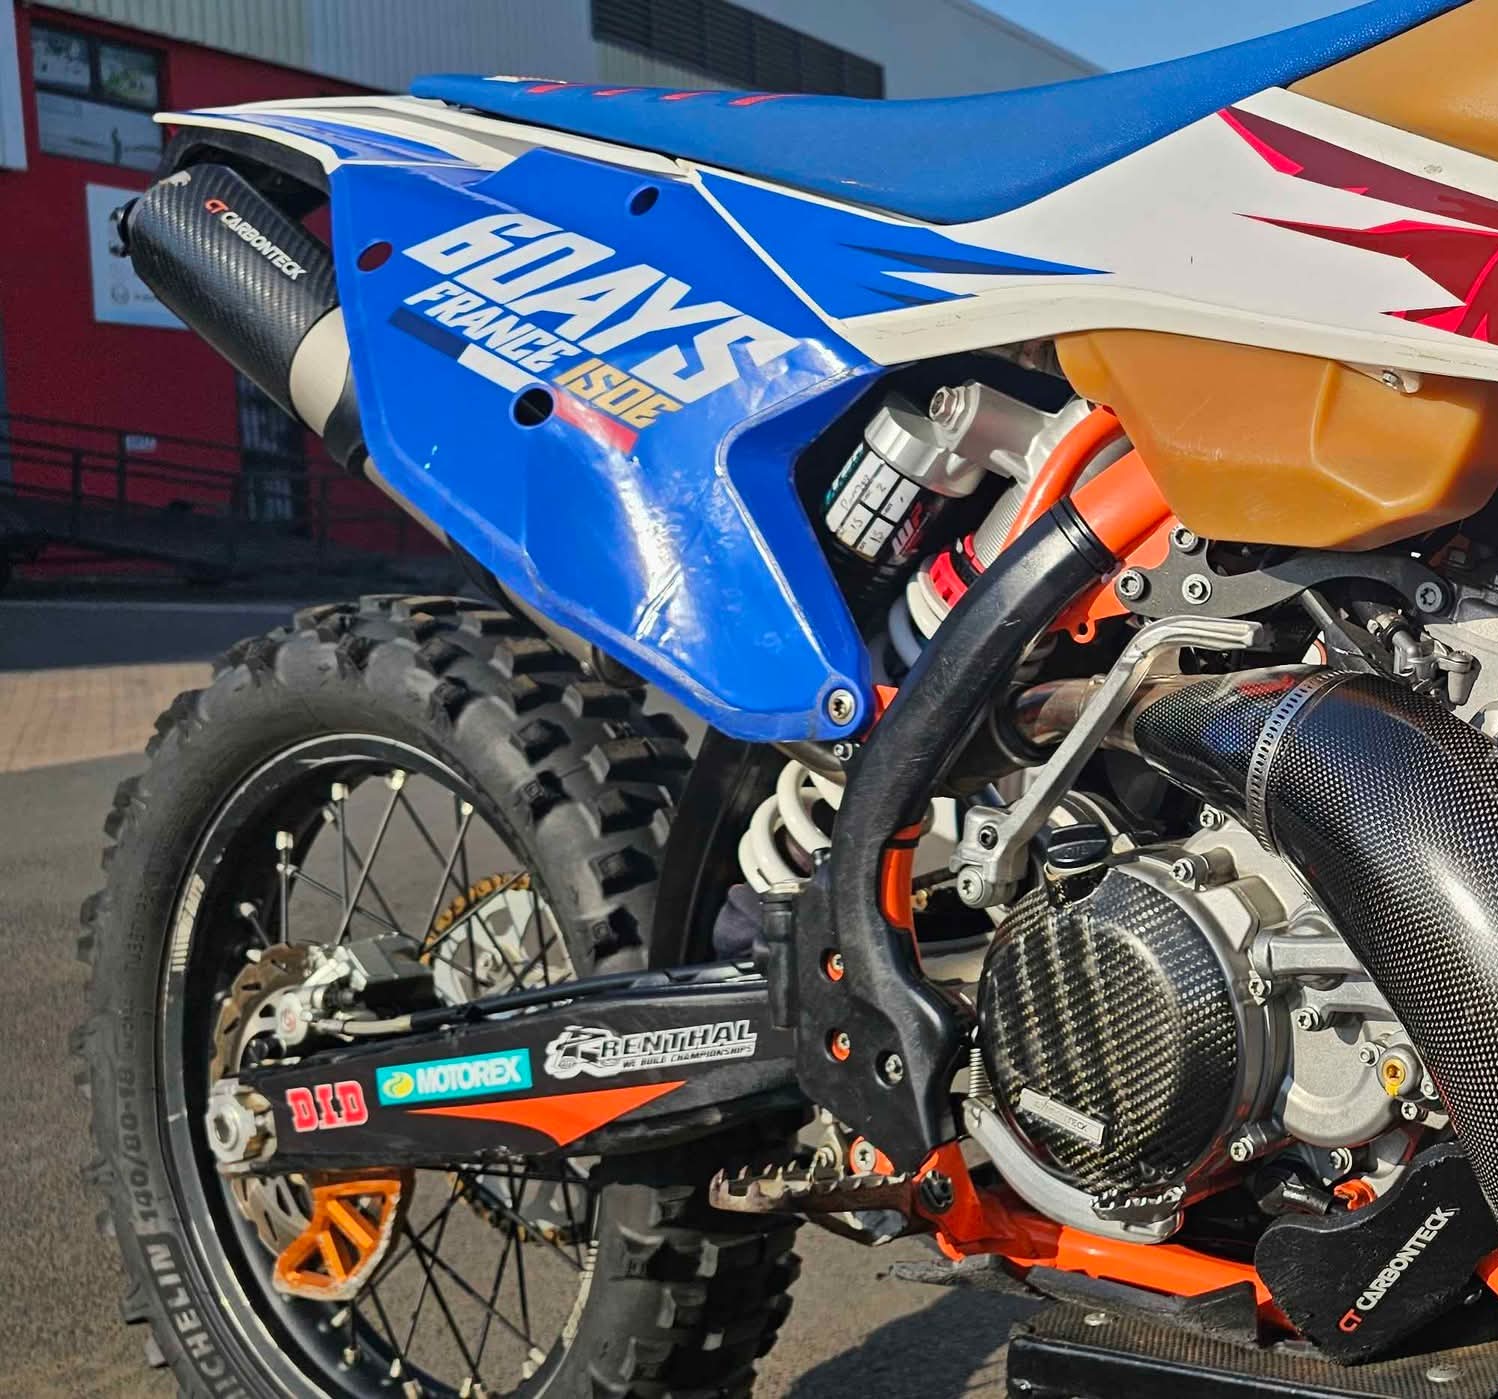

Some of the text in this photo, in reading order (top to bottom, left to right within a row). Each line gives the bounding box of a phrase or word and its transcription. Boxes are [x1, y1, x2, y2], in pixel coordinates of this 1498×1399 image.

[203, 198, 308, 281] CT CARBONTECK
[403, 280, 586, 373] FRANCE
[601, 1019, 758, 1060] RENTHAL
[285, 1080, 369, 1132] DID
[416, 1056, 522, 1095] MOTOREX
[1339, 1206, 1456, 1332] CT CARBONTECK
